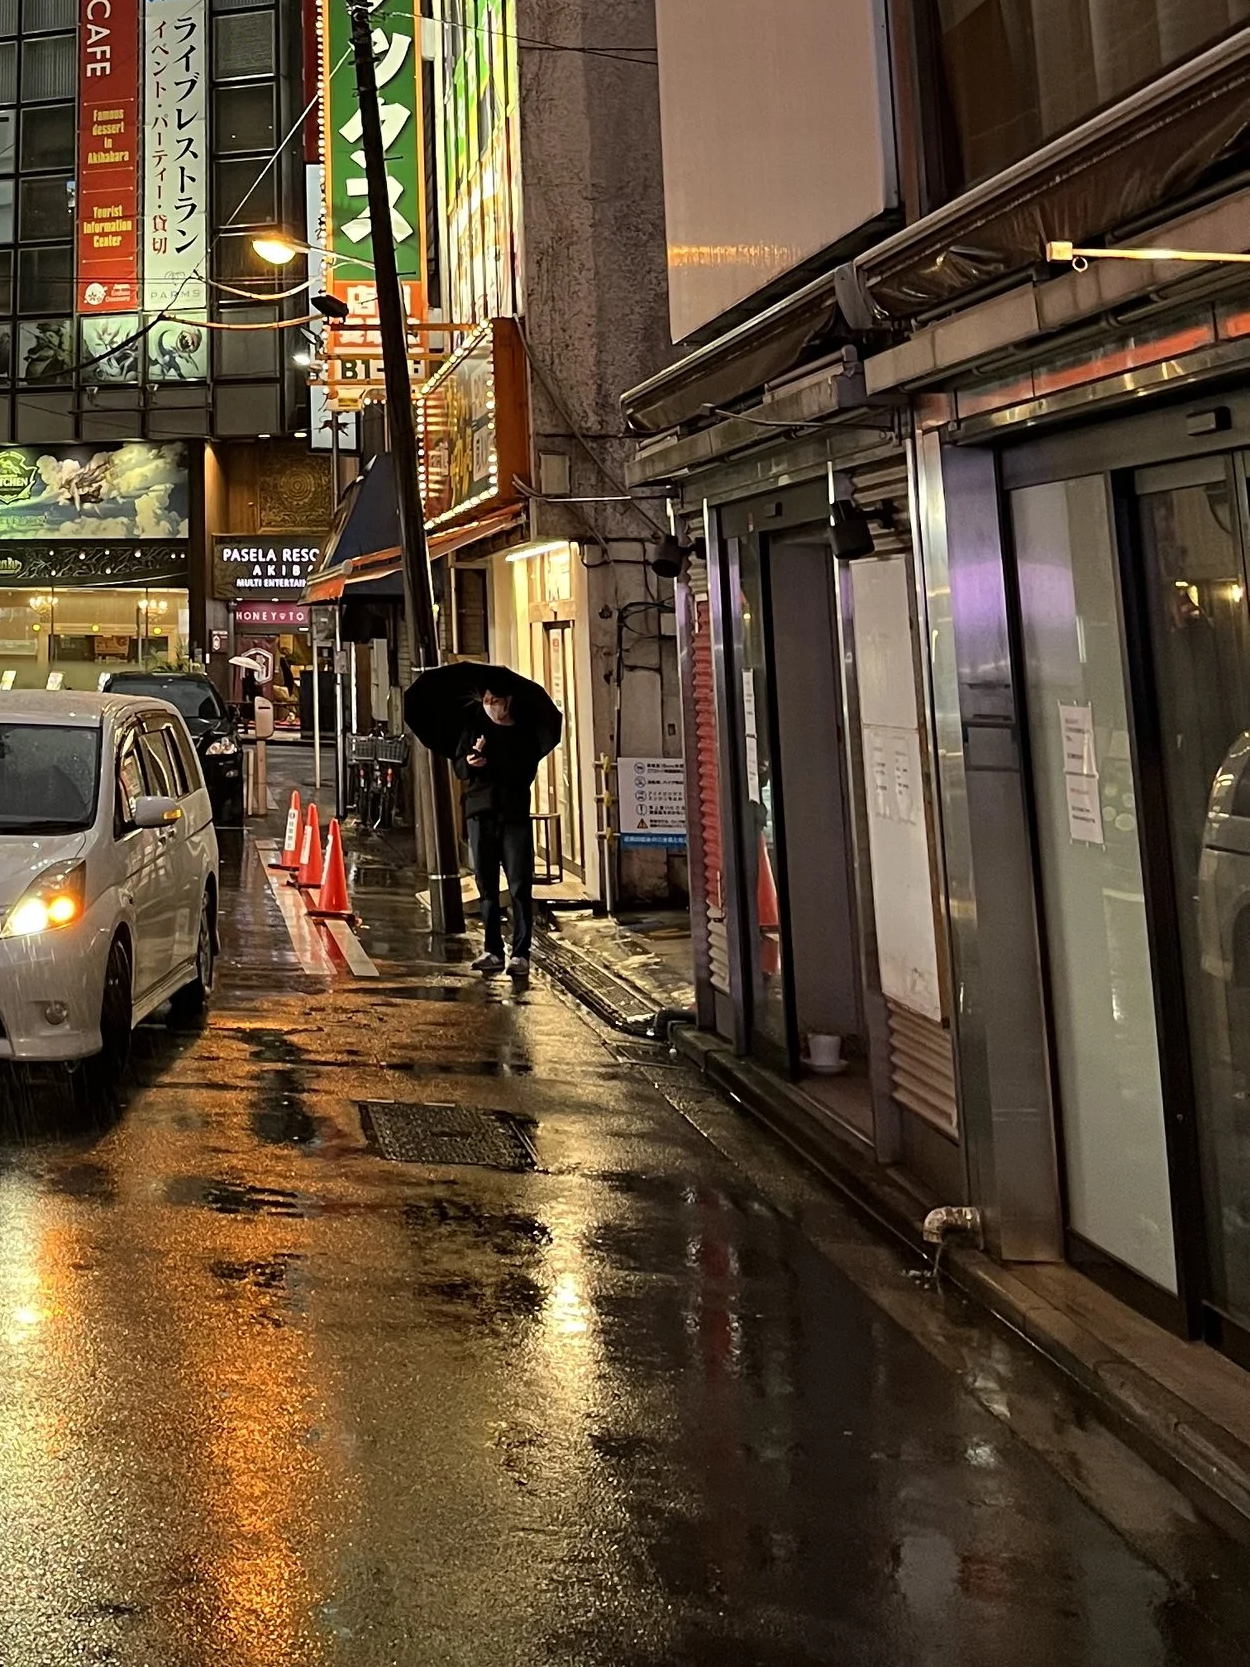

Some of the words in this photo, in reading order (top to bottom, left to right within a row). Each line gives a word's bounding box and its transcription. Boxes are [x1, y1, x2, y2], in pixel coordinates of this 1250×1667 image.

[93, 108, 124, 123] Famous
[92, 120, 124, 135] dessert
[173, 16, 200, 254] ライブレストラン
[93, 205, 123, 219] Tourist
[83, 219, 132, 236] Information
[93, 234, 123, 249] Center
[150, 289, 201, 299] PARMS
[223, 548, 277, 562] PASELA
[236, 578, 262, 587] MULTI
[236, 611, 277, 621] HONEY
